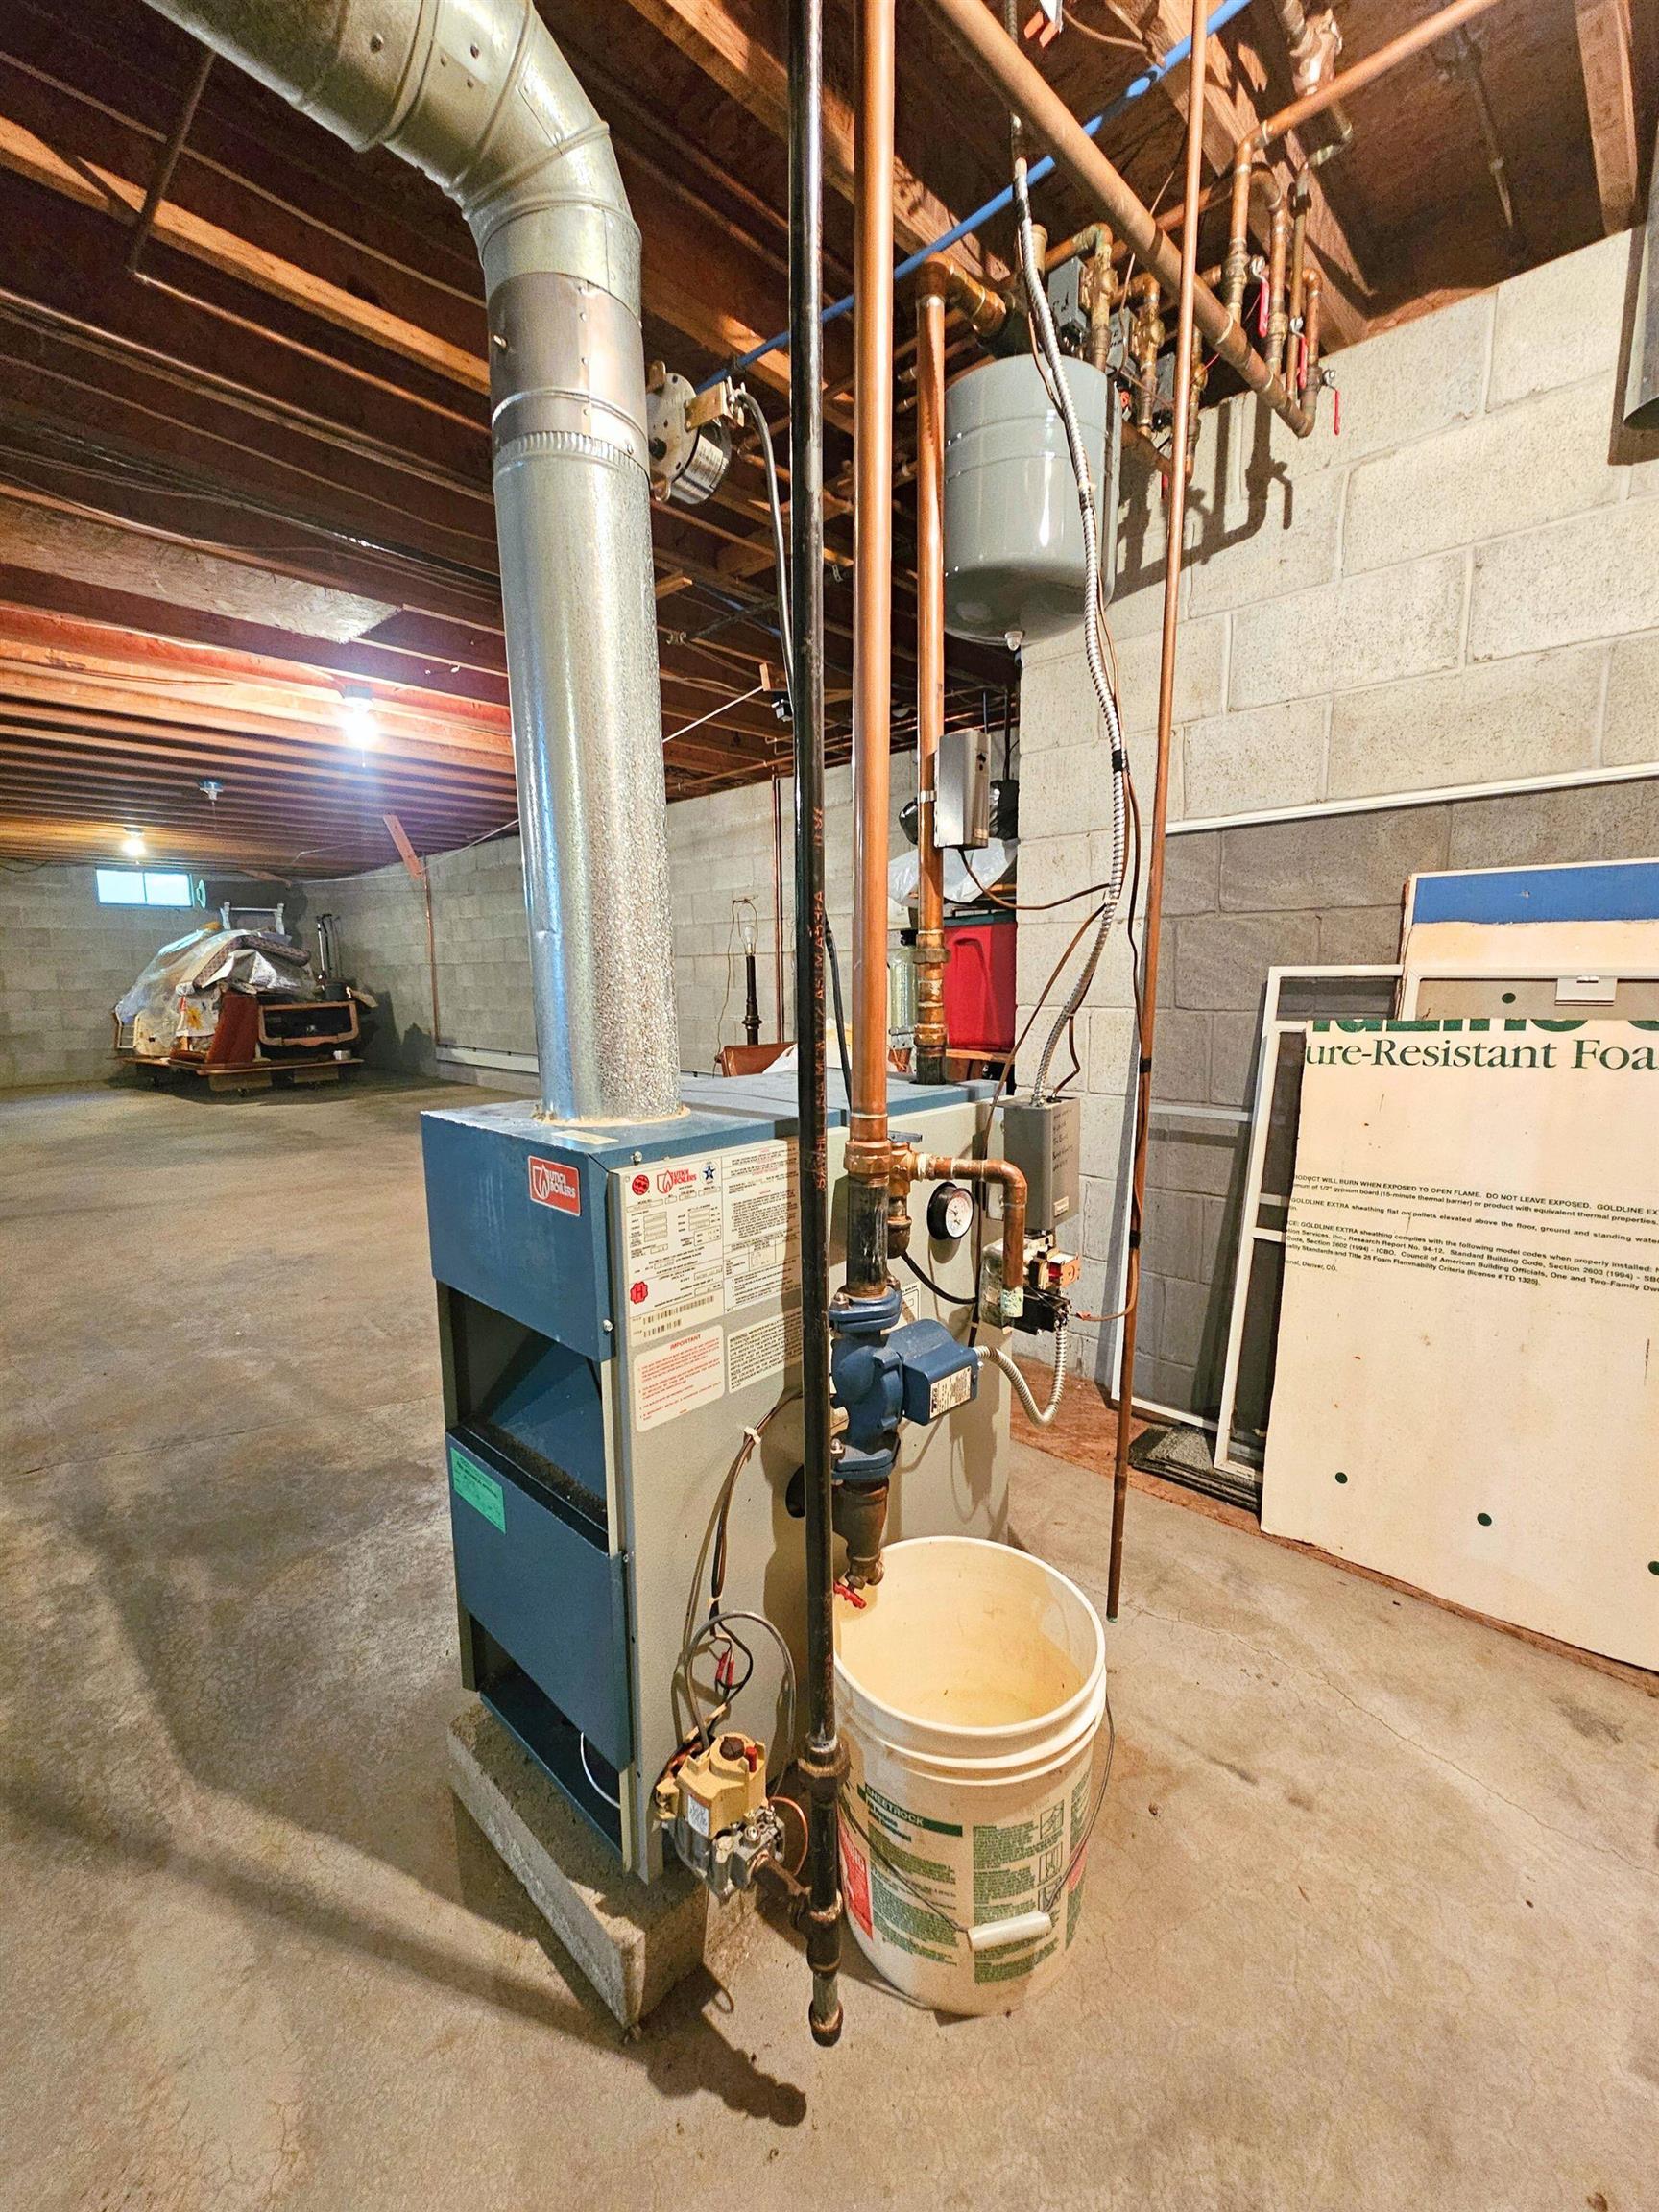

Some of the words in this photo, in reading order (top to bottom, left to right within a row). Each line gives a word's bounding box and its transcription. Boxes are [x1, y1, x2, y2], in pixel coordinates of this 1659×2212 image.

[1306, 1039, 1556, 1069] ure-Resistant
[1571, 1039, 1658, 1070] Foa
[1380, 1191, 1416, 1200] (15-minute
[1446, 1198, 1472, 1206] barrier)
[1484, 1202, 1513, 1210] product
[1534, 1207, 1575, 1217] equivalent
[1577, 1211, 1609, 1220] thermal
[1611, 1215, 1659, 1226] properties.
[1383, 1183, 1417, 1191] EXPOSED
[1454, 1190, 1481, 1198] FLAME.
[1520, 1197, 1546, 1205] LEAVE
[1548, 1199, 1591, 1209] EXPOSED.
[1597, 1203, 1643, 1214] GOLDLINE
[1352, 1205, 1384, 1214] sheathing
[1540, 1226, 1570, 1235] ground
[1593, 1232, 1632, 1242] standing
[1301, 1222, 1334, 1230] GOLDLINE
[1360, 1230, 1392, 1239] sheathing
[1395, 1234, 1426, 1243] complies
[1459, 1242, 1493, 1253] following
[1496, 1247, 1520, 1255] model
[1522, 1250, 1546, 1259] codes
[1574, 1257, 1609, 1268] properly
[1612, 1262, 1652, 1273] installed:
[1302, 1230, 1330, 1239] Services,
[1348, 1237, 1380, 1245] Research
[1382, 1240, 1406, 1249] Report
[1450, 1250, 1484, 1259] Standard
[1487, 1254, 1518, 1265] Building
[1522, 1259, 1546, 1268] Code,
[1549, 1262, 1580, 1272] Section
[1583, 1267, 1604, 1275] 2603
[1606, 1270, 1634, 1280] (1994)
[1302, 1245, 1333, 1255] Standards
[1439, 1266, 1465, 1275] Criteria
[1467, 1269, 1495, 1279] (license
[1302, 1261, 1325, 1270] Denver,
[1349, 1244, 1369, 1253] (1994)
[1401, 1252, 1428, 1260] Council
[1440, 1257, 1475, 1266] American
[1478, 1262, 1509, 1272] Building
[1512, 1266, 1547, 1278] Officials,
[1550, 1271, 1568, 1281] One
[1589, 1277, 1640, 1291] Two-Family
[670, 1334, 701, 1350] IMPORTANT
